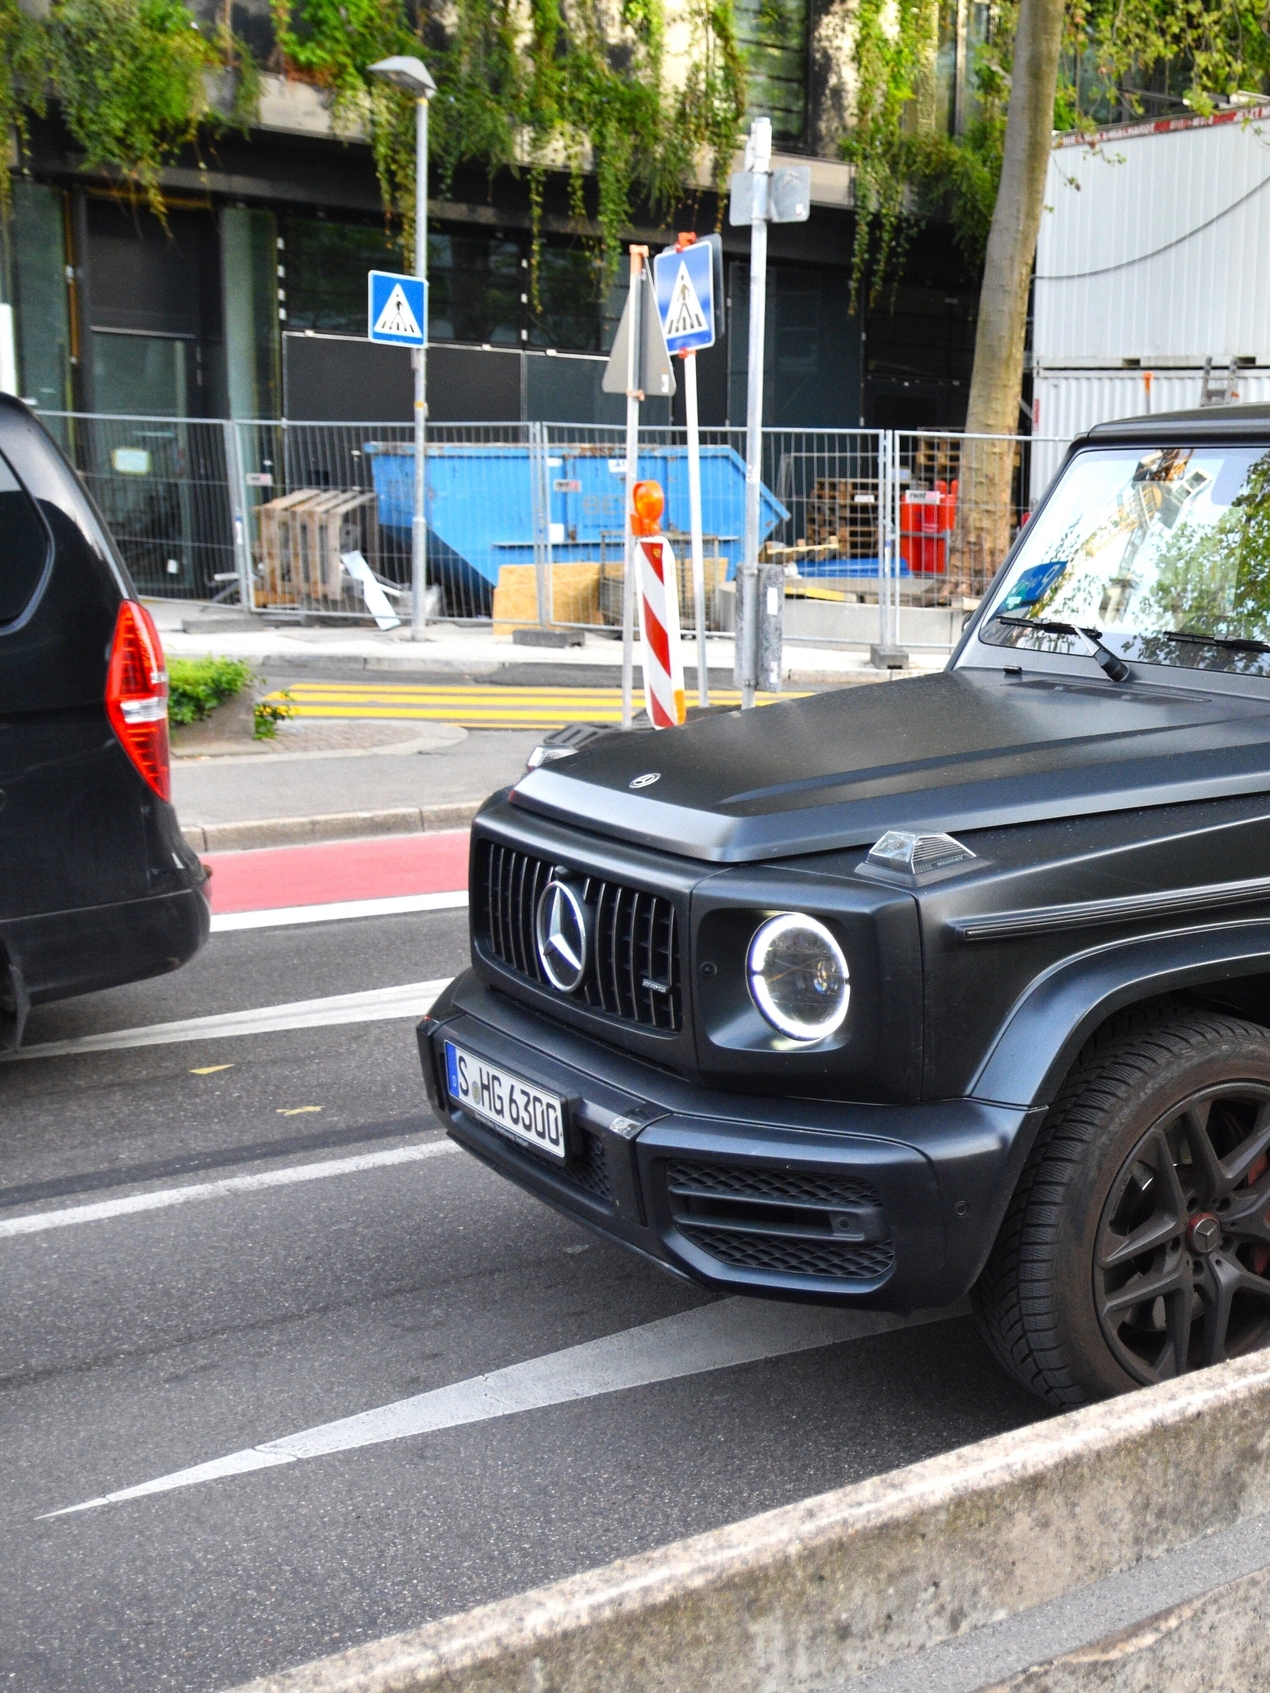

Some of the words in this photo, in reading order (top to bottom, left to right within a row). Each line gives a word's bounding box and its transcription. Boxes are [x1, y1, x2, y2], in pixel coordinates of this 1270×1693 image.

[458, 1055, 470, 1097] S
[479, 1067, 504, 1118] HG
[509, 1084, 560, 1146] 6300
